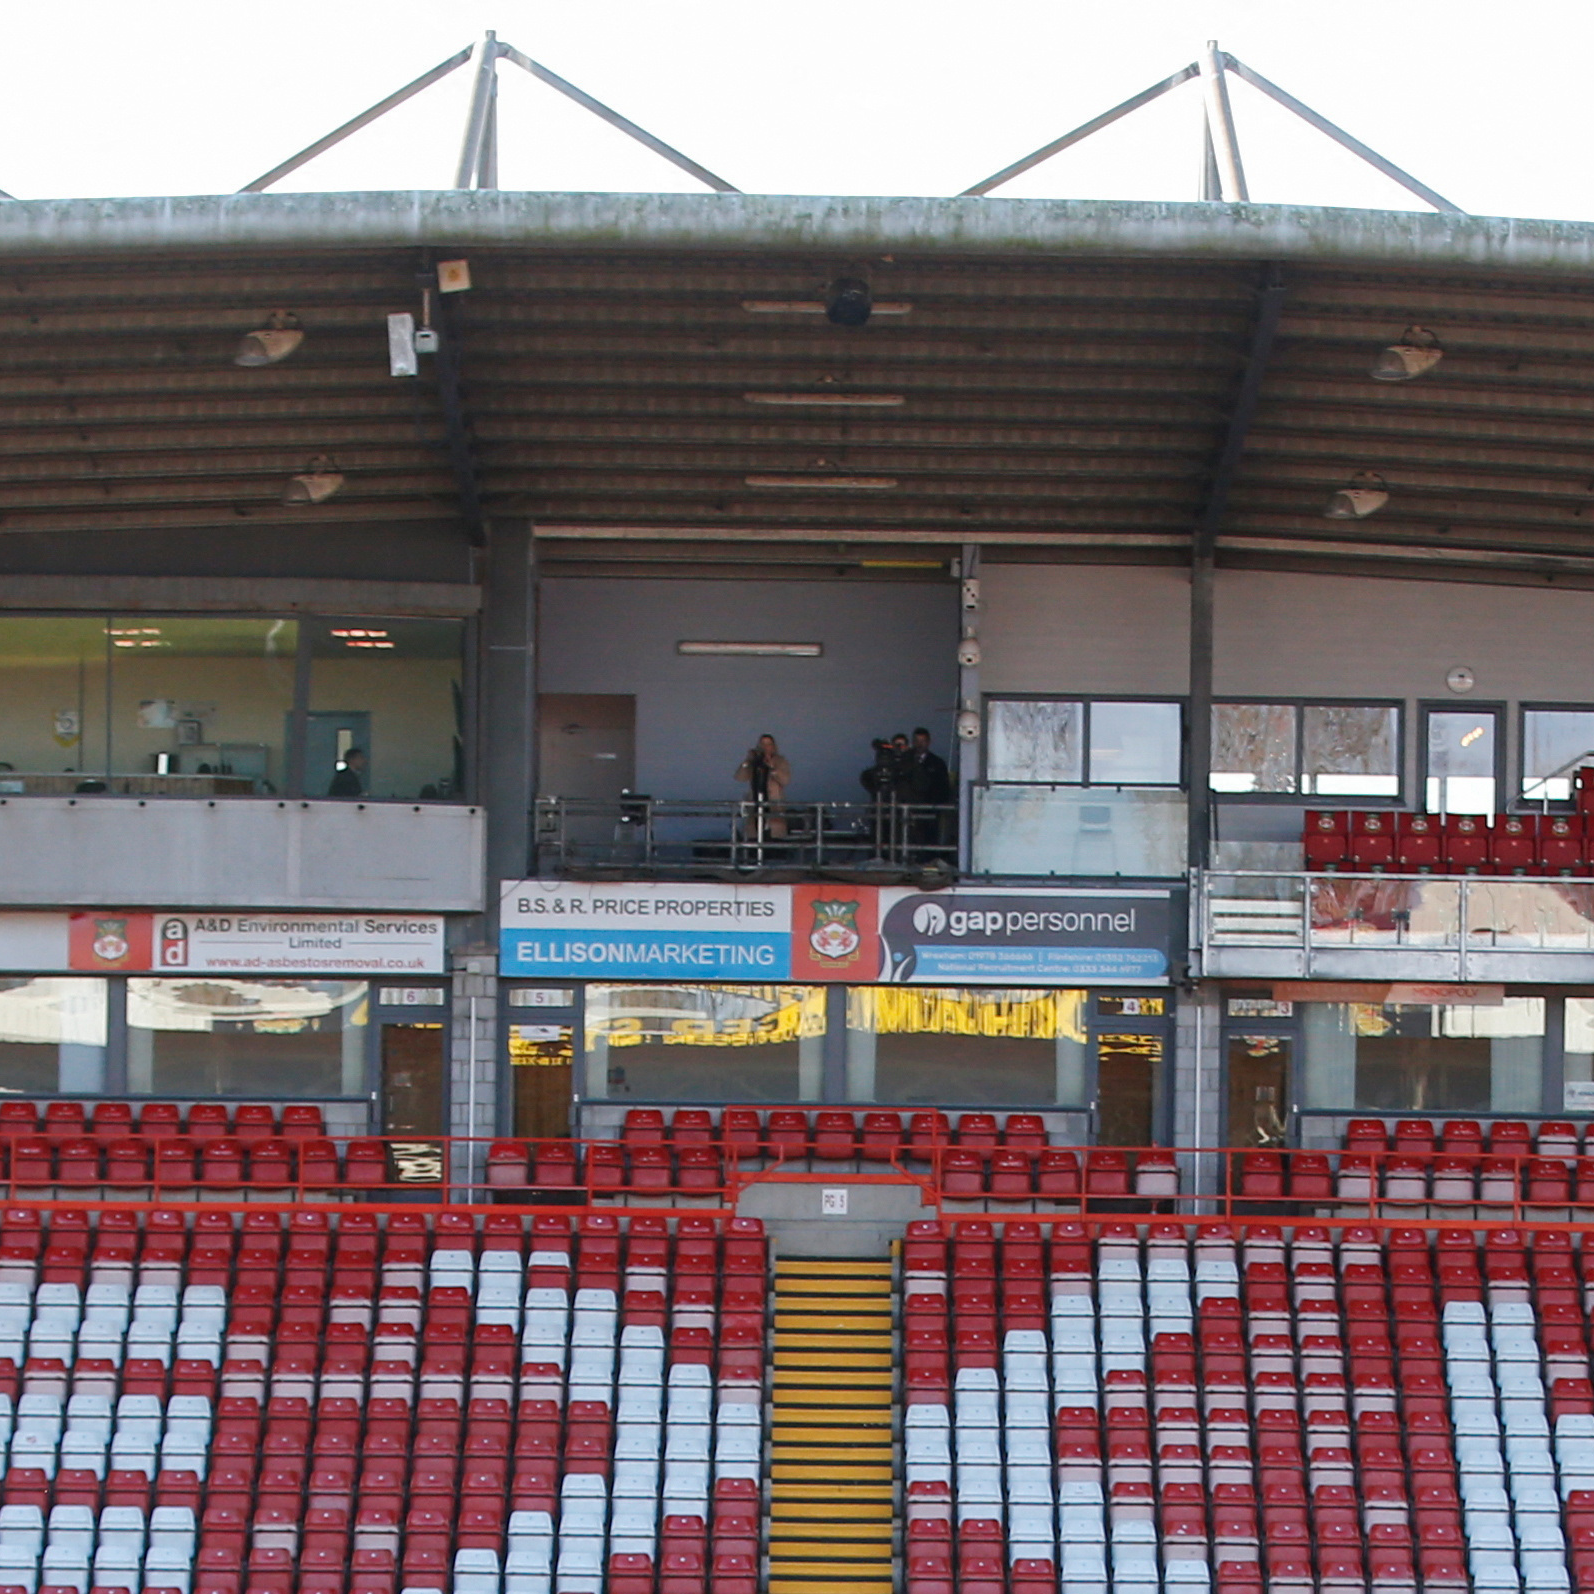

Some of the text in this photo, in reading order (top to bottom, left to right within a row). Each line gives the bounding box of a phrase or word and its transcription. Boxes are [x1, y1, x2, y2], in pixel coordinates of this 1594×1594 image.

[517, 898, 775, 916] B.S. & R. PRICE PROPERTIES
[194, 919, 438, 934] A&D Environmental Services
[289, 937, 342, 949] Limited
[516, 942, 775, 965] ELLISONMARKETING
[205, 957, 425, 969] www.ad-asbestosremoval.co.uk
[535, 992, 544, 1004] 5
[1127, 1001, 1136, 1013] 4
[1280, 1002, 1289, 1014] 3
